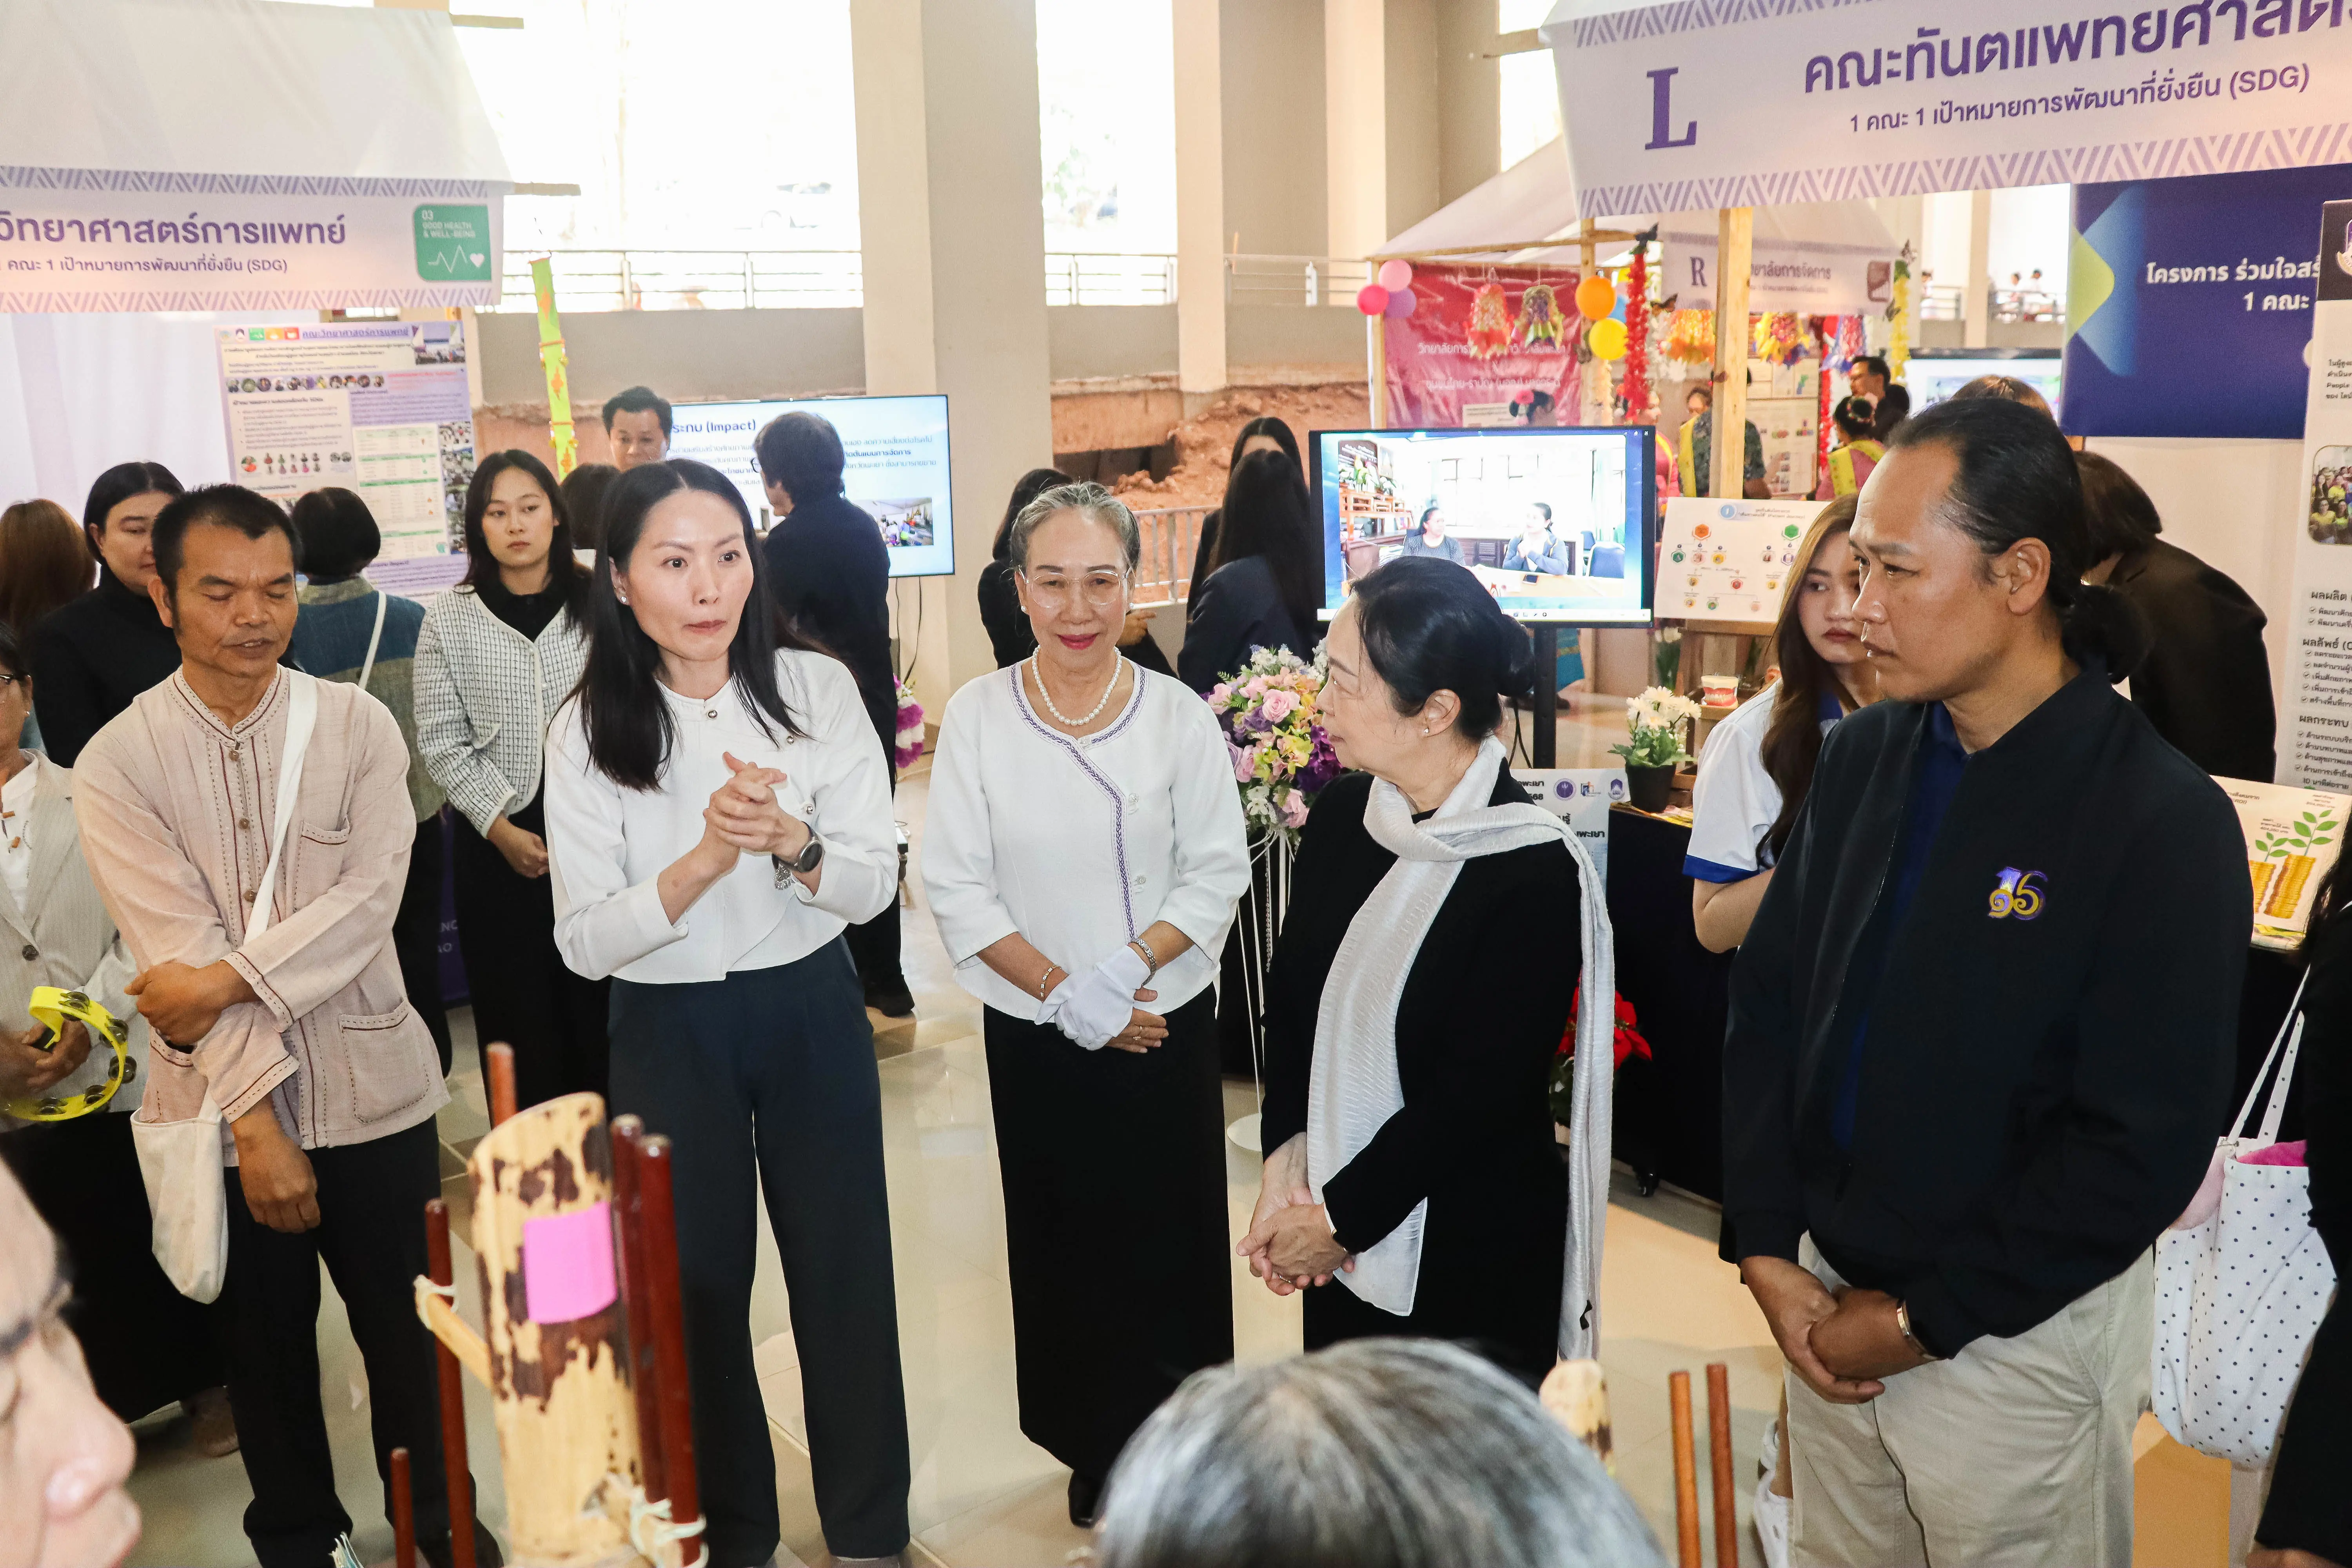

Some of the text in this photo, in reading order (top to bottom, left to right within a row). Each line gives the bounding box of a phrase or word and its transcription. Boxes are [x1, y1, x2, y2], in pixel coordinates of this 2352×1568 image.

[1805, 0, 2352, 93] คณะทันตแพทยศาสต
[1851, 63, 2310, 132] 1 คณะ 1 เป้าหมายการพัฒนาที่ยั่งยืน (SDG)
[1646, 67, 1697, 150] L
[8, 253, 287, 274] คณะ 1 เป้าหมายการพัฒนาที่ยั่งยืน (SDG)
[1690, 256, 1708, 287] R
[2147, 261, 2229, 284] โครงการ
[2243, 292, 2310, 311] 1 คณะ
[707, 419, 756, 433] (Impact)
[2311, 590, 2347, 601] ผลผลิต
[2303, 637, 2339, 648] ผลลัพธ์
[2299, 715, 2349, 728] ผลกระทบ
